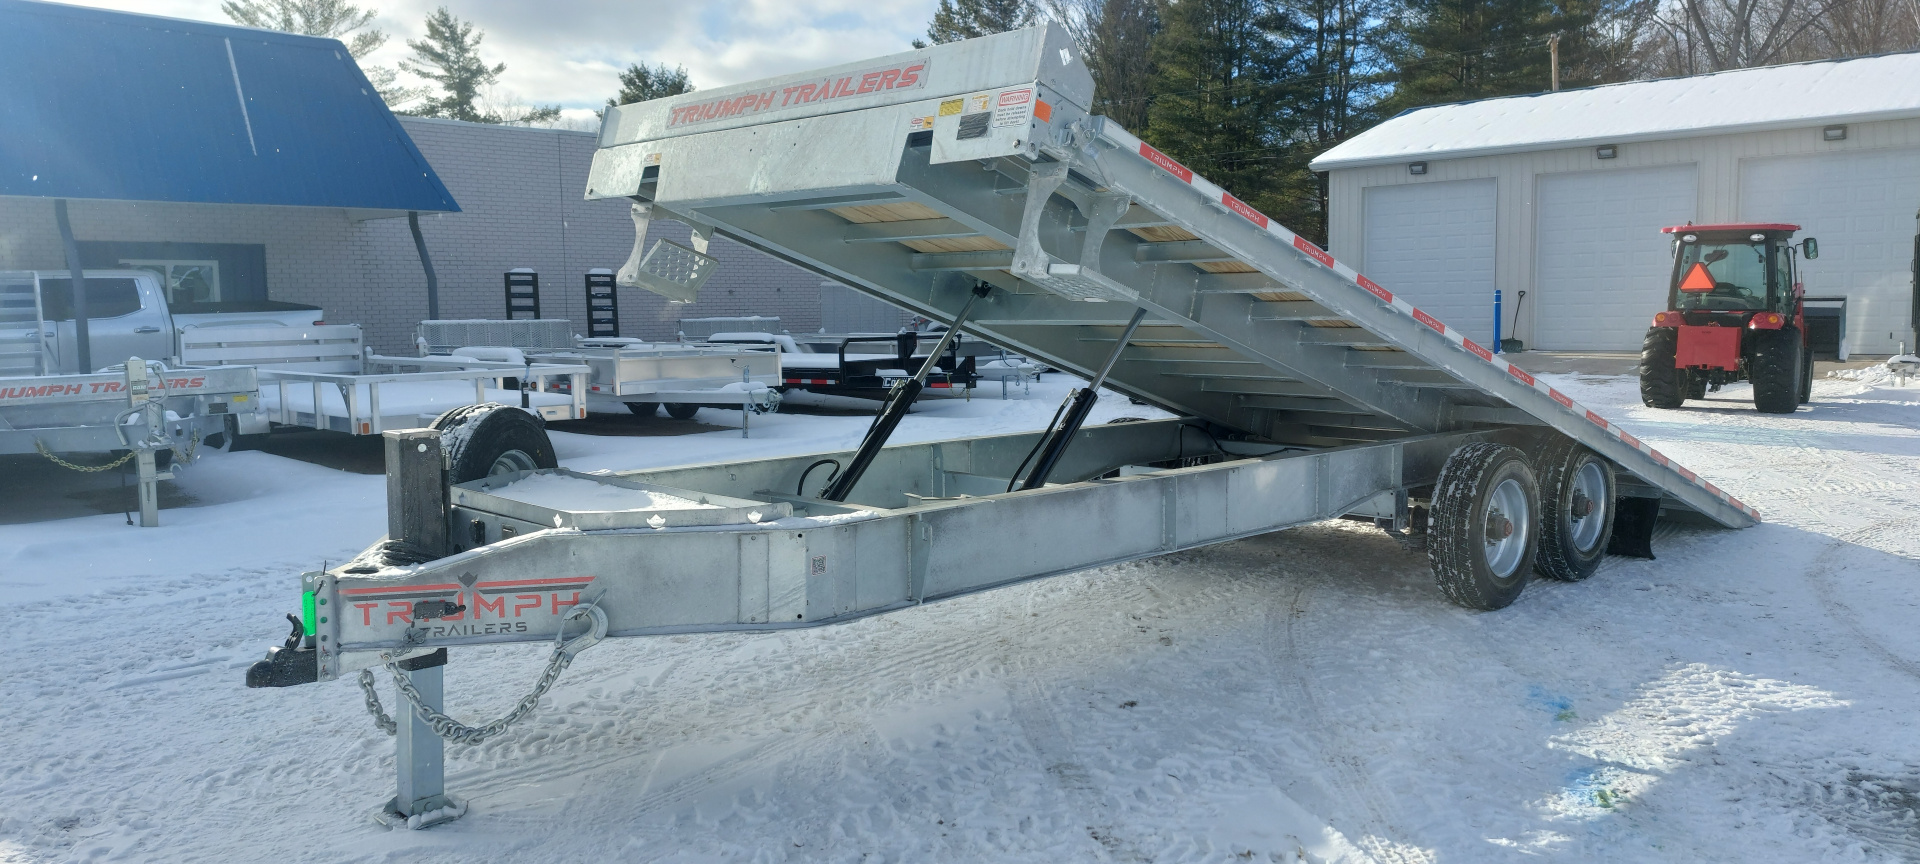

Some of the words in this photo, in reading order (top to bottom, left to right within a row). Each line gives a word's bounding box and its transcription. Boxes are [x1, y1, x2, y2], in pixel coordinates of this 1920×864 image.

[670, 90, 777, 126] TRIUMPH
[781, 64, 925, 107] TRAILERS
[1001, 93, 1029, 103] WARNING
[1150, 152, 1183, 176] TRIUMPH
[1231, 200, 1260, 222] TRIUMPH
[1302, 242, 1327, 262] TRIUMPH
[1363, 281, 1387, 297] TRIUMPH
[353, 591, 582, 626] TRUMPH
